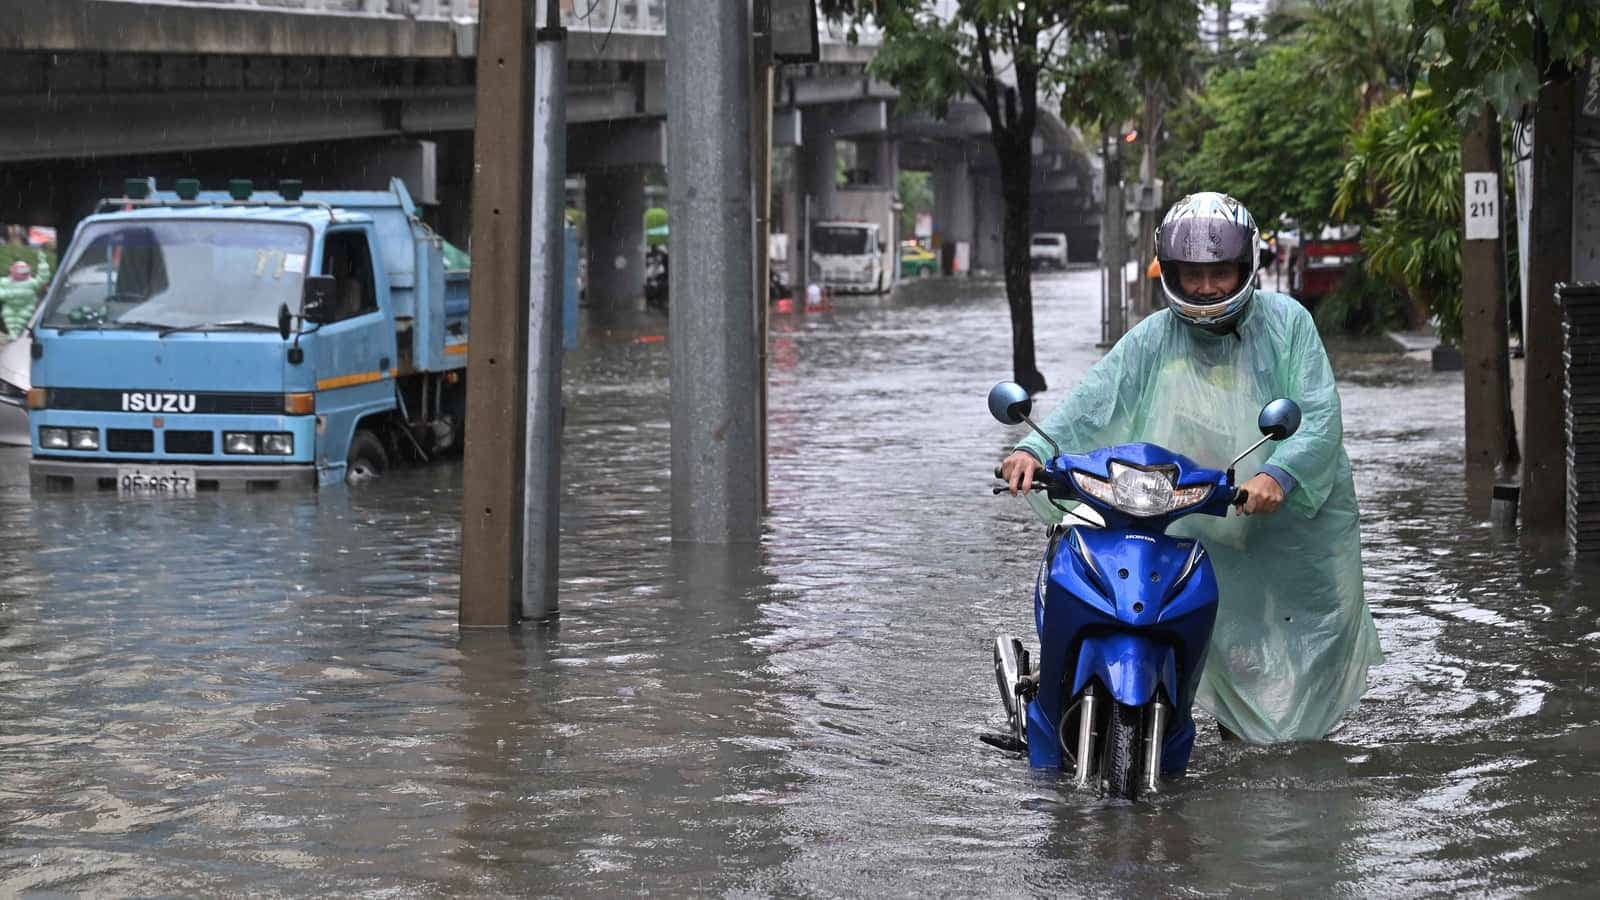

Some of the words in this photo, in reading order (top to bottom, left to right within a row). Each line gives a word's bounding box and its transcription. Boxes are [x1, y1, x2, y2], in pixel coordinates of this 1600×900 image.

[1475, 179, 1488, 195] ก
[1470, 201, 1494, 218] 211
[121, 392, 196, 413] ISUZU
